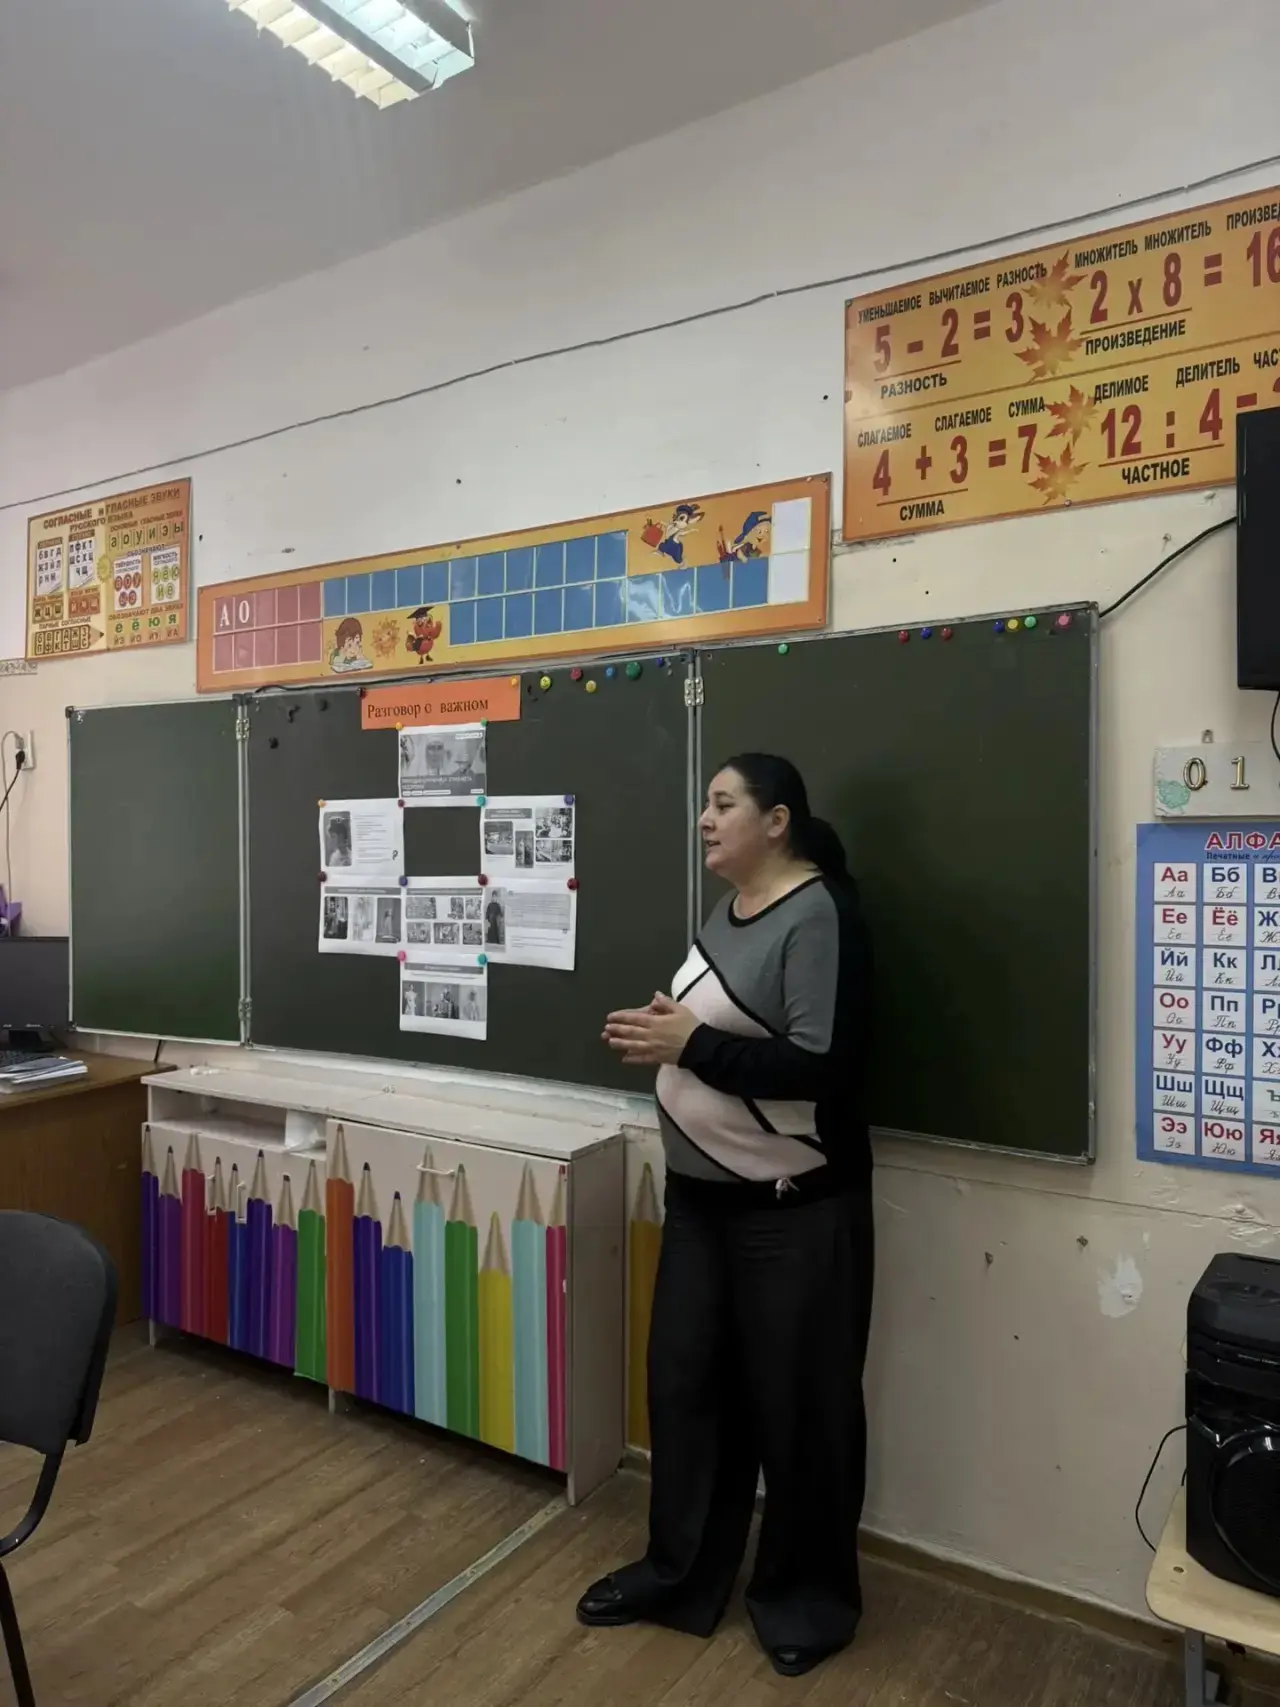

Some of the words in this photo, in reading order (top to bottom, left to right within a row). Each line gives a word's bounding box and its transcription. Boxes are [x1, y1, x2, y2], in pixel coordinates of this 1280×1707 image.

[858, 295, 922, 324] УМЕНЬШАЕМОЕ
[929, 277, 990, 306] ВЫЧИТАЕМОЕ
[997, 262, 1048, 288] РАЗНОСТЬ
[1074, 239, 1138, 269] МНОЖИТЕЛЬ
[1144, 220, 1212, 252] МНОЖИТЕЛЬ
[1090, 270, 1108, 324] 2
[1163, 252, 1182, 307] 8
[873, 324, 891, 373] 5
[941, 308, 959, 358] 2
[1005, 292, 1024, 343] 3
[1085, 319, 1186, 356] ПРОИЗВЕДЕНИЕ
[857, 422, 912, 448] СЛАГАЕМОЕ
[934, 406, 992, 432] СЛАГАЕМОЕ
[1008, 397, 1045, 418] СУММА
[1093, 375, 1149, 405] ДЕЛИМОЕ
[1176, 357, 1240, 388] ДЕЛИТЕЛЬ
[1253, 347, 1280, 369] ЧАС
[881, 373, 948, 399] РАЗНОСТЬ
[1101, 404, 1142, 459] 12
[1199, 388, 1223, 441] 4
[873, 449, 891, 496] 4
[950, 434, 968, 484] 3
[1018, 423, 1038, 473] 7
[1121, 457, 1190, 484] ЧАСТНОЕ
[43, 508, 92, 530] СОГЛАСНЫЕ
[105, 495, 149, 514] ГЛАСНЫЕ
[150, 488, 180, 503] ЗВУКИ
[899, 500, 945, 521] СУММА
[70, 518, 106, 532] РУССКОГО
[111, 537, 117, 547] а
[123, 534, 130, 544] о
[136, 530, 142, 545] у
[149, 528, 155, 539] и
[162, 525, 168, 536] э
[174, 522, 183, 533] ы
[115, 623, 123, 633] е
[132, 618, 139, 631] ё
[148, 617, 160, 627] ю
[168, 614, 176, 624] я
[367, 703, 421, 719] Разговор
[440, 700, 489, 714] важном
[1230, 756, 1250, 791] 1
[1206, 852, 1250, 860] Печатные
[1160, 866, 1188, 882] Аа
[1211, 866, 1240, 883] Бб
[1262, 867, 1280, 883] В
[1216, 886, 1239, 898] Бб
[1266, 887, 1280, 900] В
[1162, 908, 1188, 924] Ее
[1212, 907, 1239, 926] Ёё
[1258, 910, 1280, 926] Ж
[1161, 948, 1188, 966] Йй
[1213, 952, 1238, 968] Кк
[1260, 954, 1280, 970] Л
[1160, 993, 1189, 1009] Оо
[1211, 995, 1239, 1012] Пп
[1262, 998, 1280, 1019] Р
[1162, 1033, 1187, 1054] Уу
[1206, 1037, 1243, 1058] Фф
[1262, 1041, 1280, 1058] Х
[1156, 1074, 1192, 1093] Шш
[1205, 1079, 1244, 1101] Щщ
[1161, 1117, 1188, 1134] Ээ
[1204, 1122, 1243, 1141] Юю
